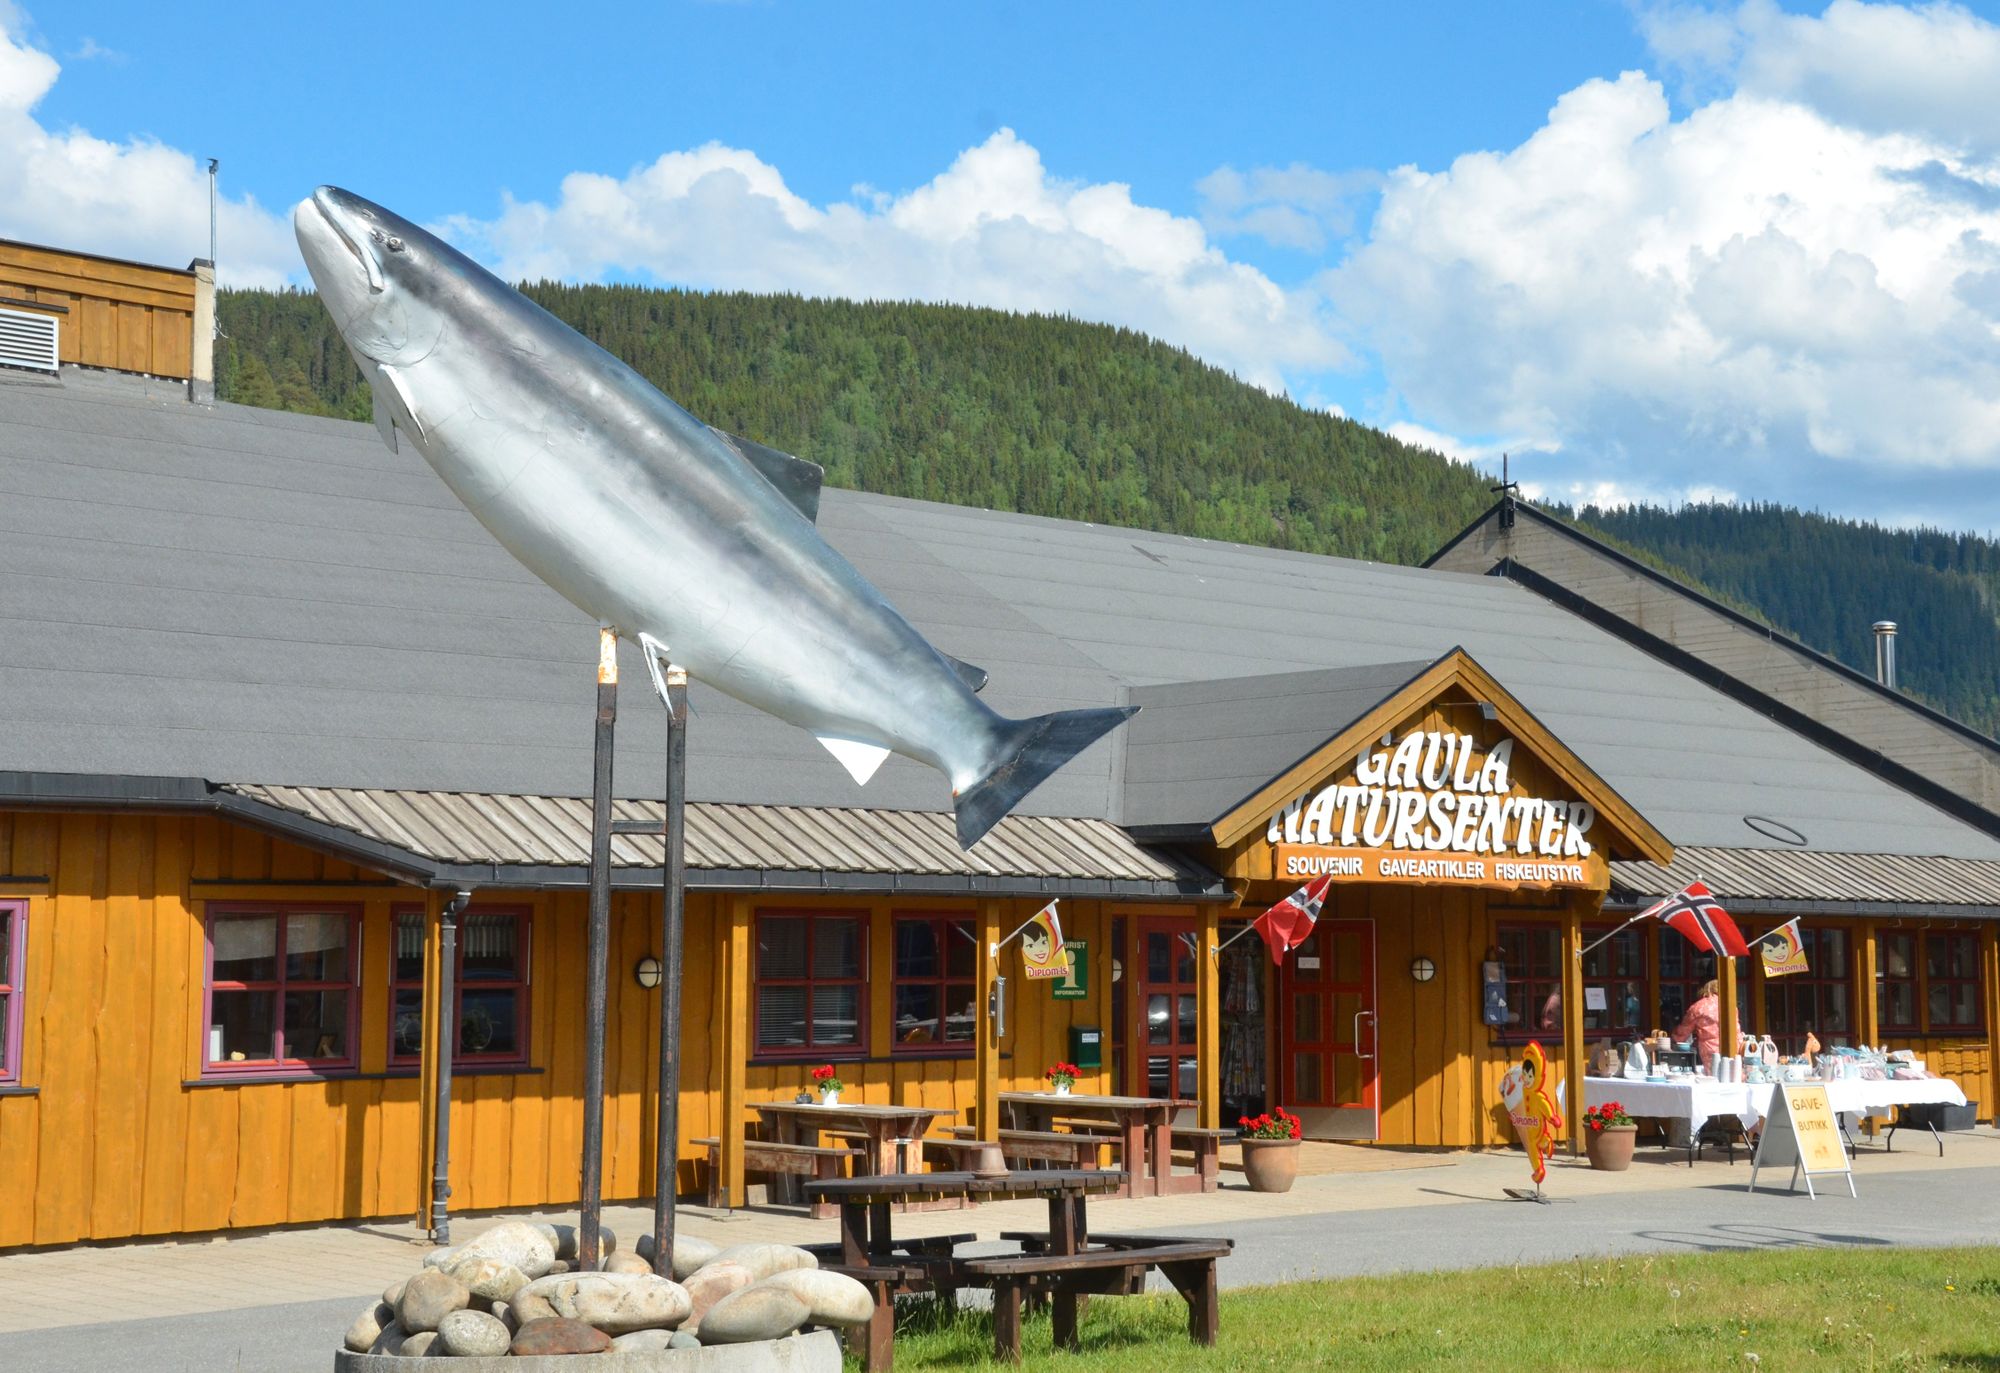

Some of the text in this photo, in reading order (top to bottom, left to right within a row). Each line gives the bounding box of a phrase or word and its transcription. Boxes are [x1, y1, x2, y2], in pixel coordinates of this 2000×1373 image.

[1357, 731, 1513, 794] GAULA
[1267, 785, 1594, 856] NATURSENTER
[1287, 857, 1583, 881] SOUVENIR GAVEARTIKLER FISKEUTSTYR
[1792, 1098, 1823, 1111] GAVE-
[1798, 1120, 1829, 1131] BUTIKK
